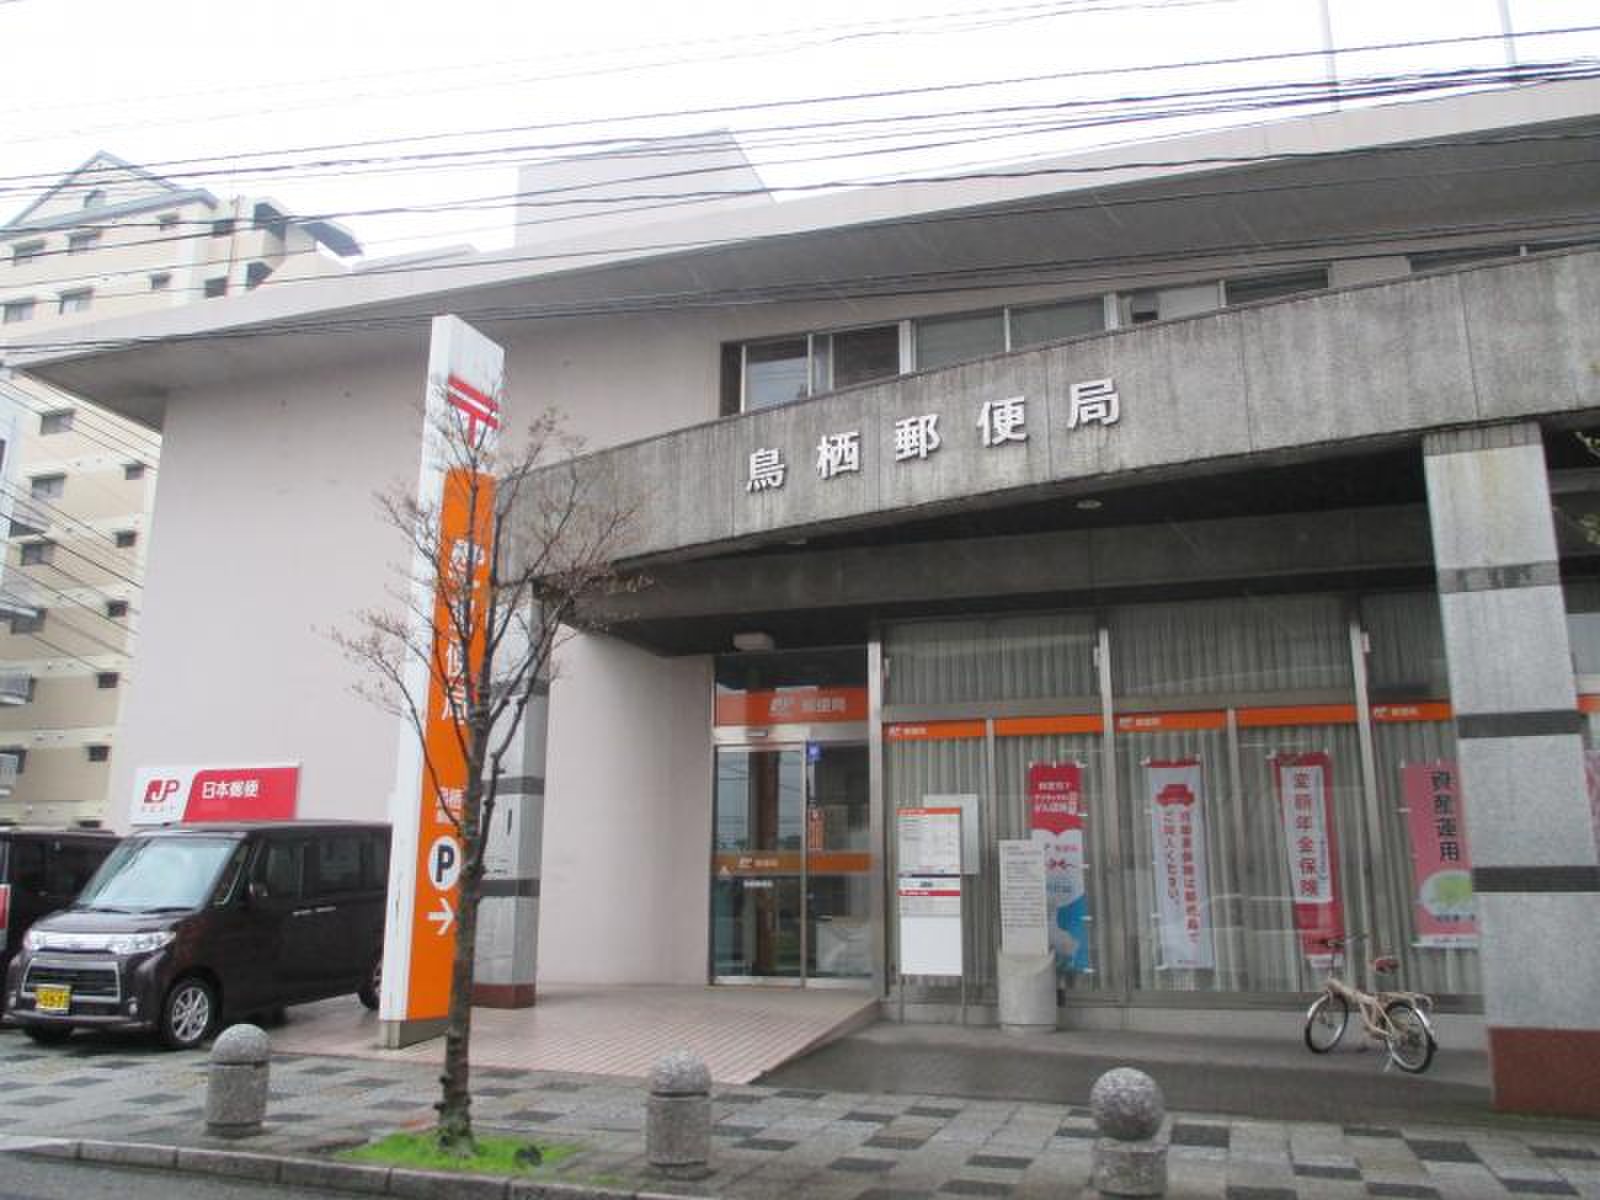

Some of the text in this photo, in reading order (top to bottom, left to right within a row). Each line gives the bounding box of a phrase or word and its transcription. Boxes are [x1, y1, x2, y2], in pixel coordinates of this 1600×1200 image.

[745, 378, 1121, 493] 鳥栖郵便局
[202, 779, 259, 799] 日本郵便
[1430, 768, 1459, 863] 資産運用
[436, 847, 455, 883] P
